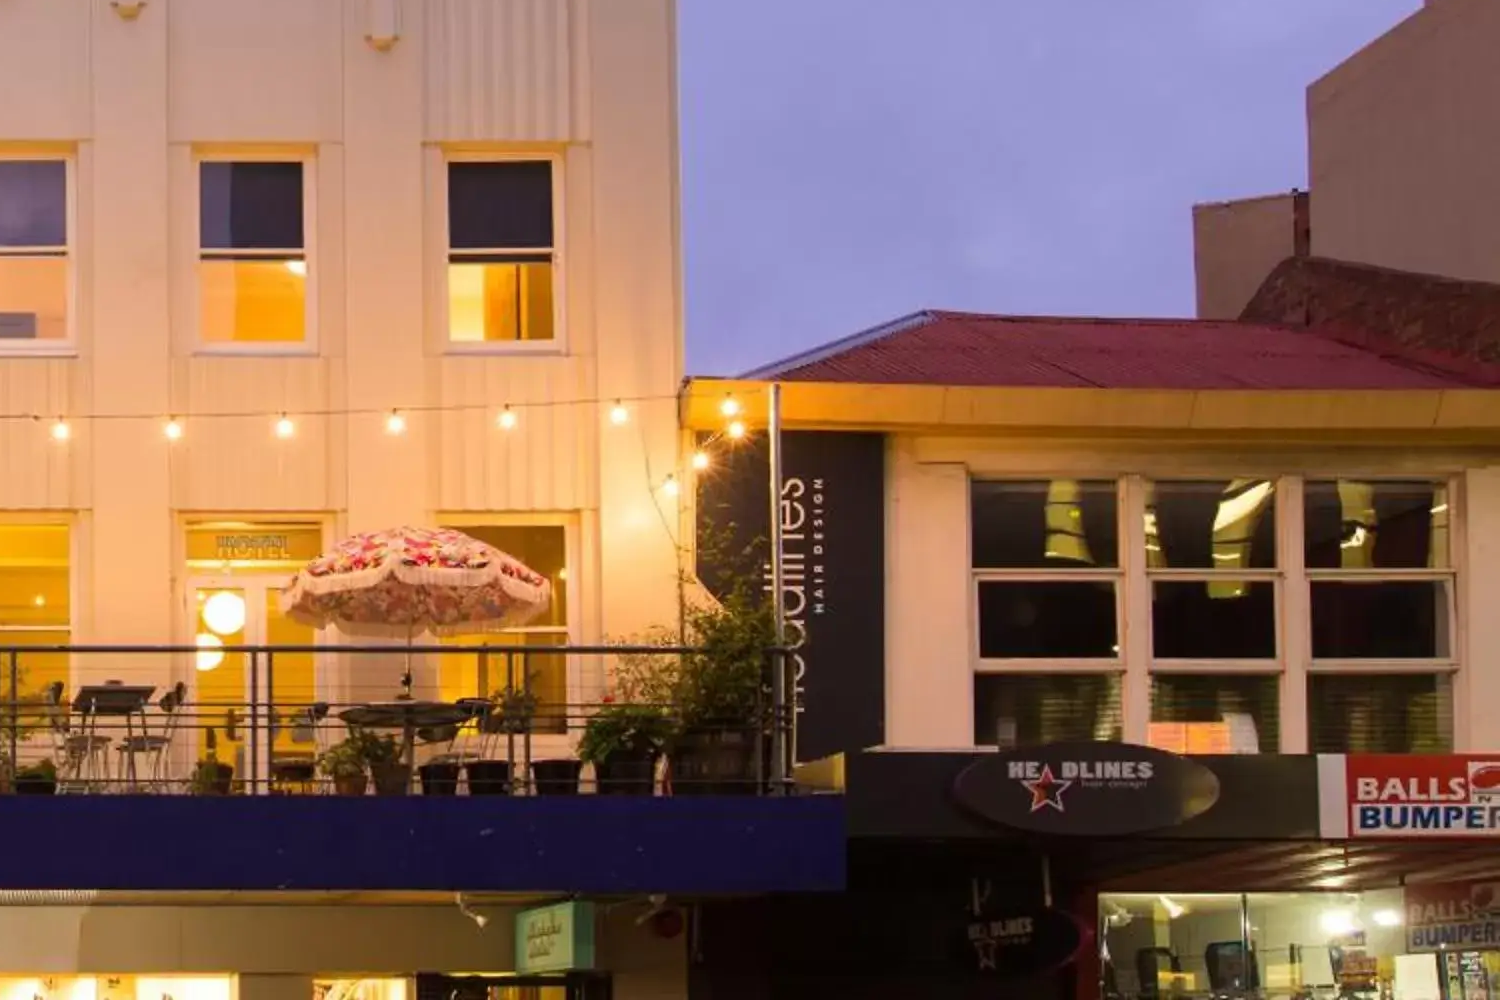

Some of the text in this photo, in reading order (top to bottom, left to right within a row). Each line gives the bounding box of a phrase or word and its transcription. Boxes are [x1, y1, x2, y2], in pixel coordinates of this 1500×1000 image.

[813, 478, 824, 614] HAIR DESIGN
[1357, 777, 1467, 801] BALLS
